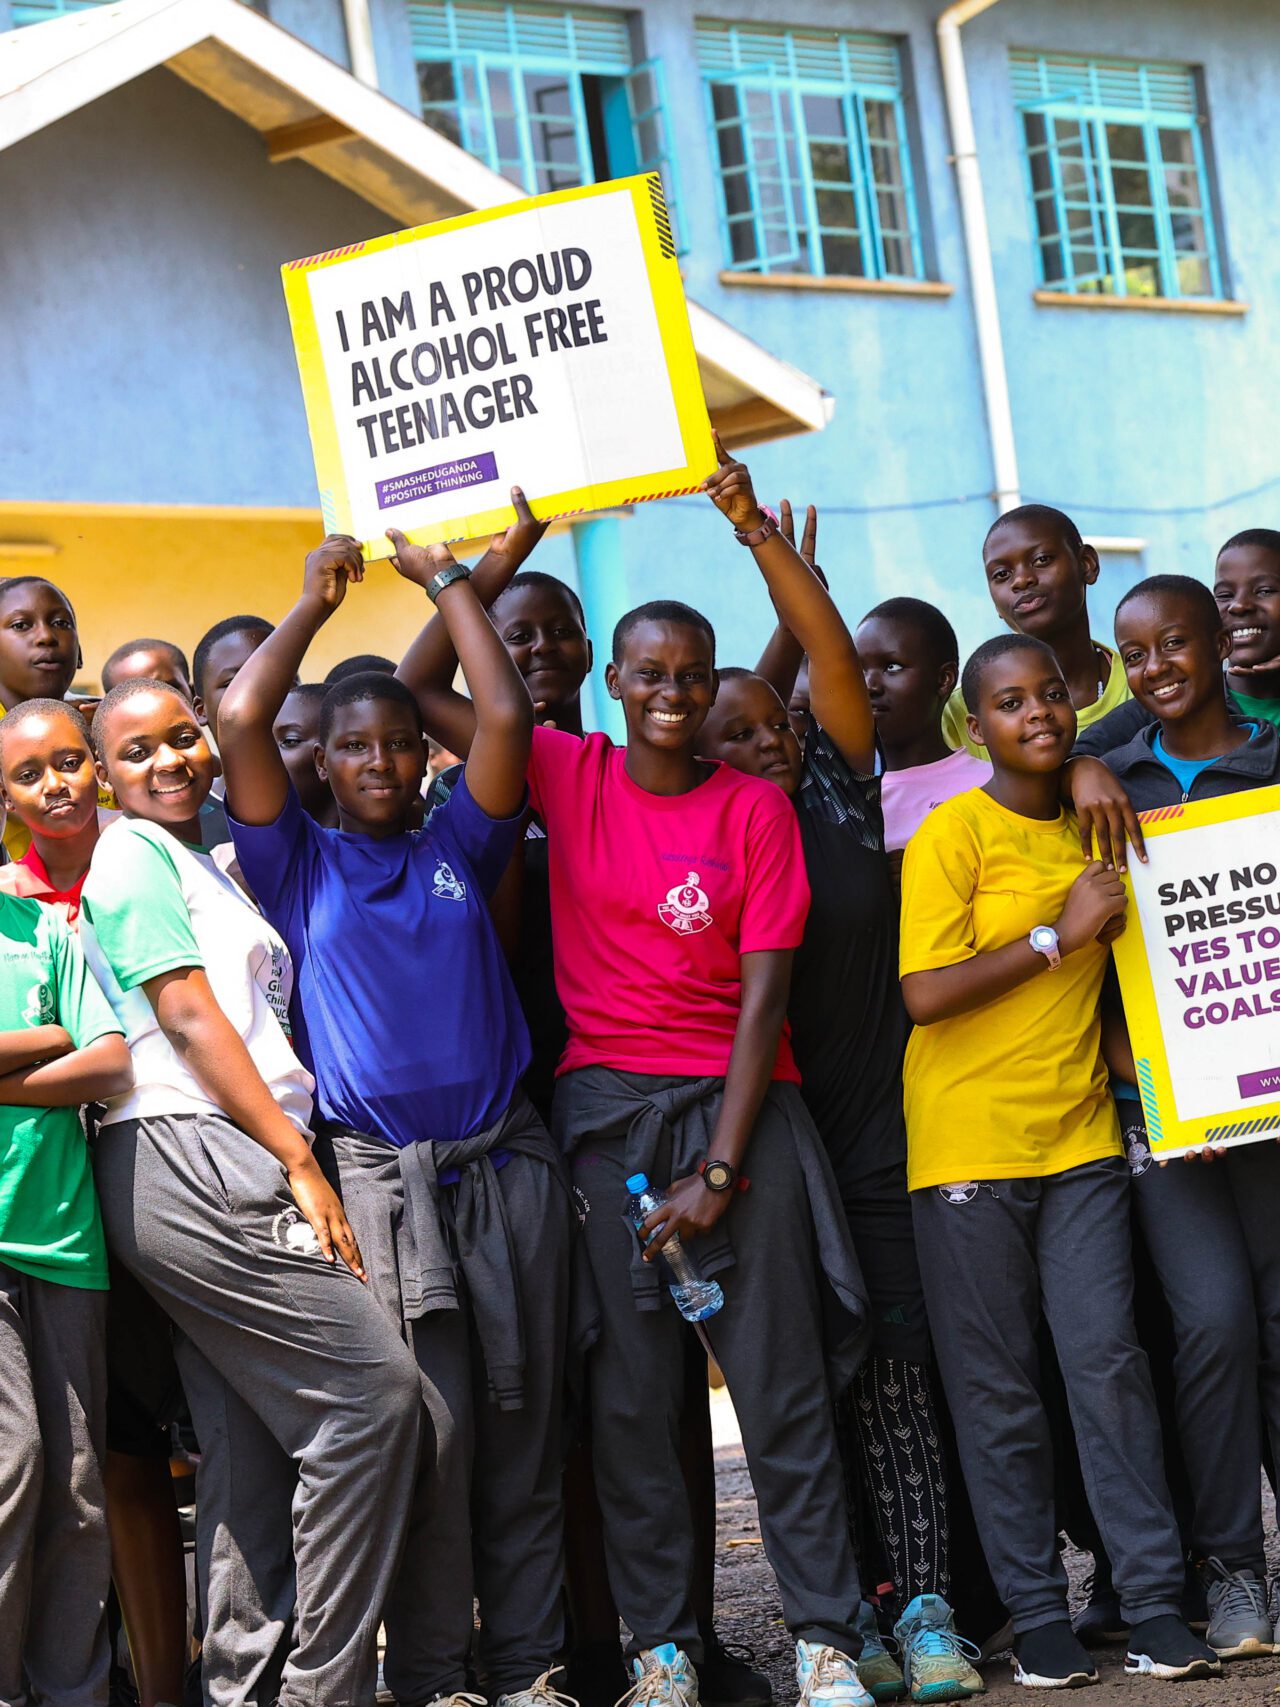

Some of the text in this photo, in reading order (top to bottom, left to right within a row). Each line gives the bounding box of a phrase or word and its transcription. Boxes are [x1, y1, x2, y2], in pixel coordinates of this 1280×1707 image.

[335, 247, 593, 352] I AM A PROUD
[351, 298, 608, 407] ALCOHOL FREE
[356, 373, 538, 459] TEENAGER
[381, 460, 478, 494] #SMASHEDUGANDA
[382, 470, 484, 506] #POSITIVE THINKING
[1157, 872, 1220, 906] SAY
[1230, 862, 1277, 893] NO
[1168, 935, 1230, 968] YES
